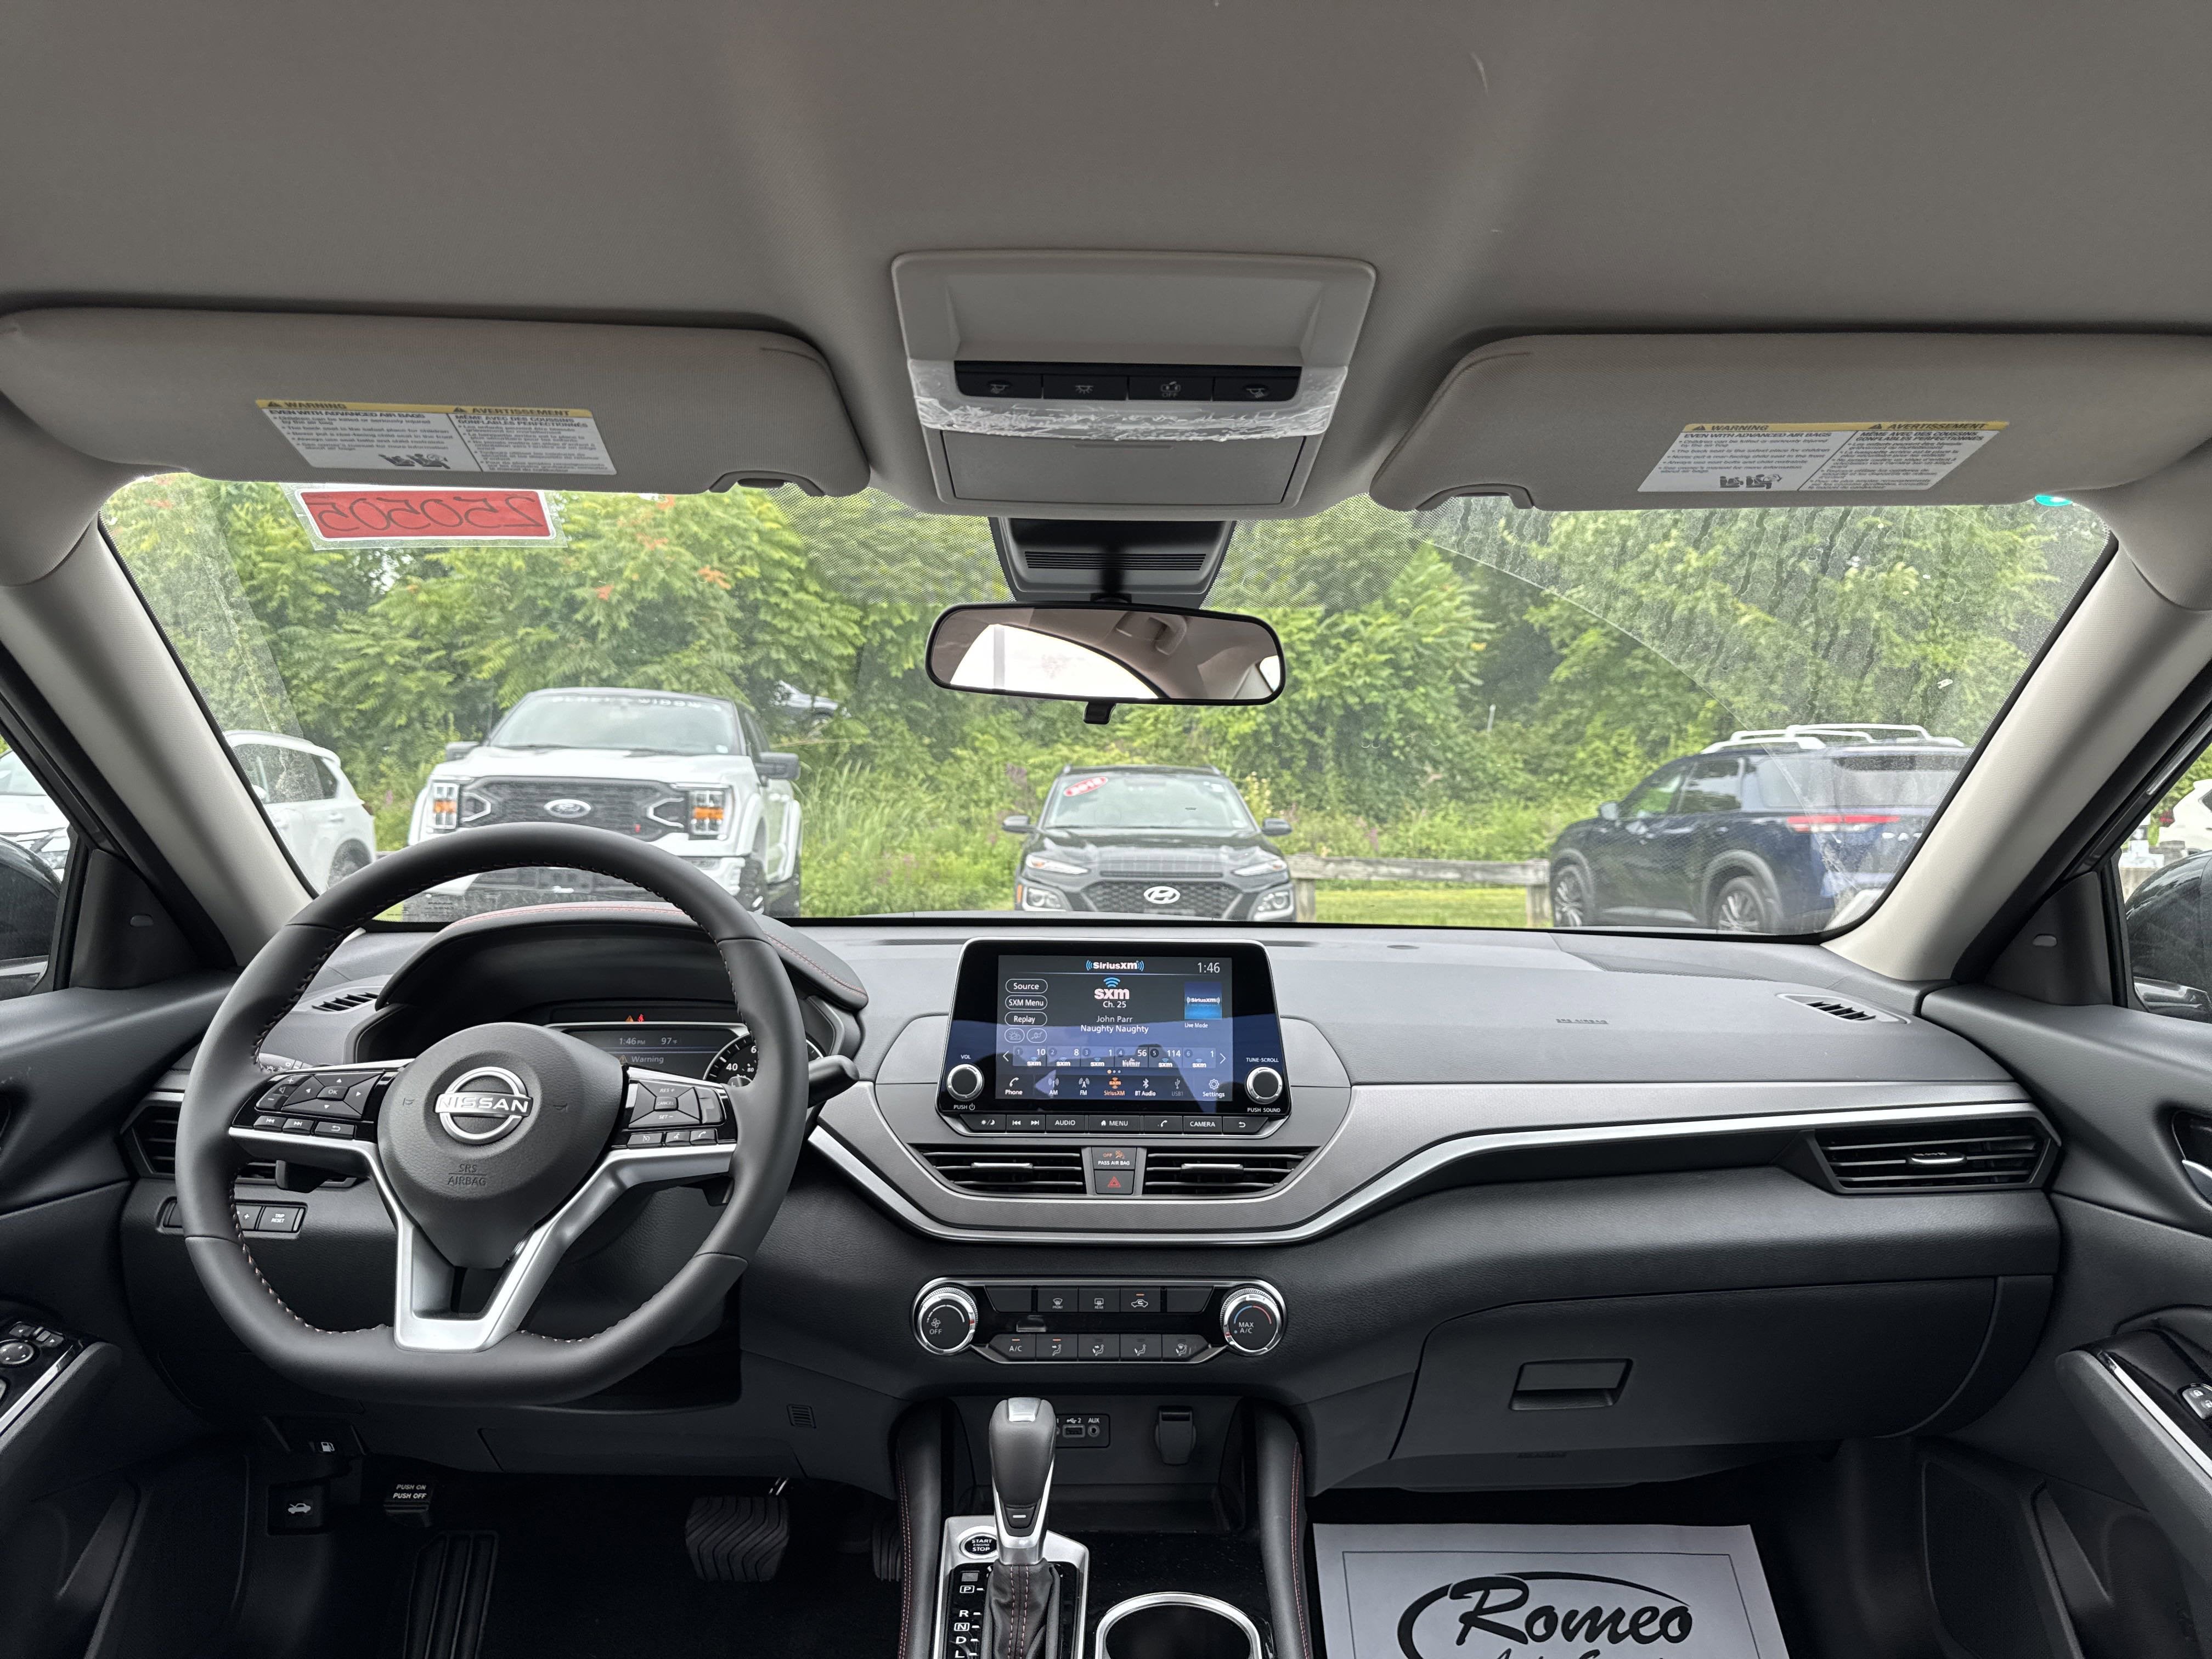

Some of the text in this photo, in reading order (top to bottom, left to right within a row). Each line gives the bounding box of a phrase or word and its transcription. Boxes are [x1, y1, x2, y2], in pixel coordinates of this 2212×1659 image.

[1197, 962, 1220, 973] 1:46
[1094, 988, 1130, 1000] sxm
[1080, 1025, 1149, 1034] Naughty Naughty
[619, 1037, 637, 1045] 1:46
[726, 1063, 738, 1071] 40
[438, 1097, 529, 1113] NISSAN
[459, 1164, 478, 1173] SRS
[447, 1176, 487, 1186] AIRBAG
[1449, 1576, 1692, 1646] Romeo
[956, 1636, 967, 1644] D
[955, 1650, 965, 1658] L
